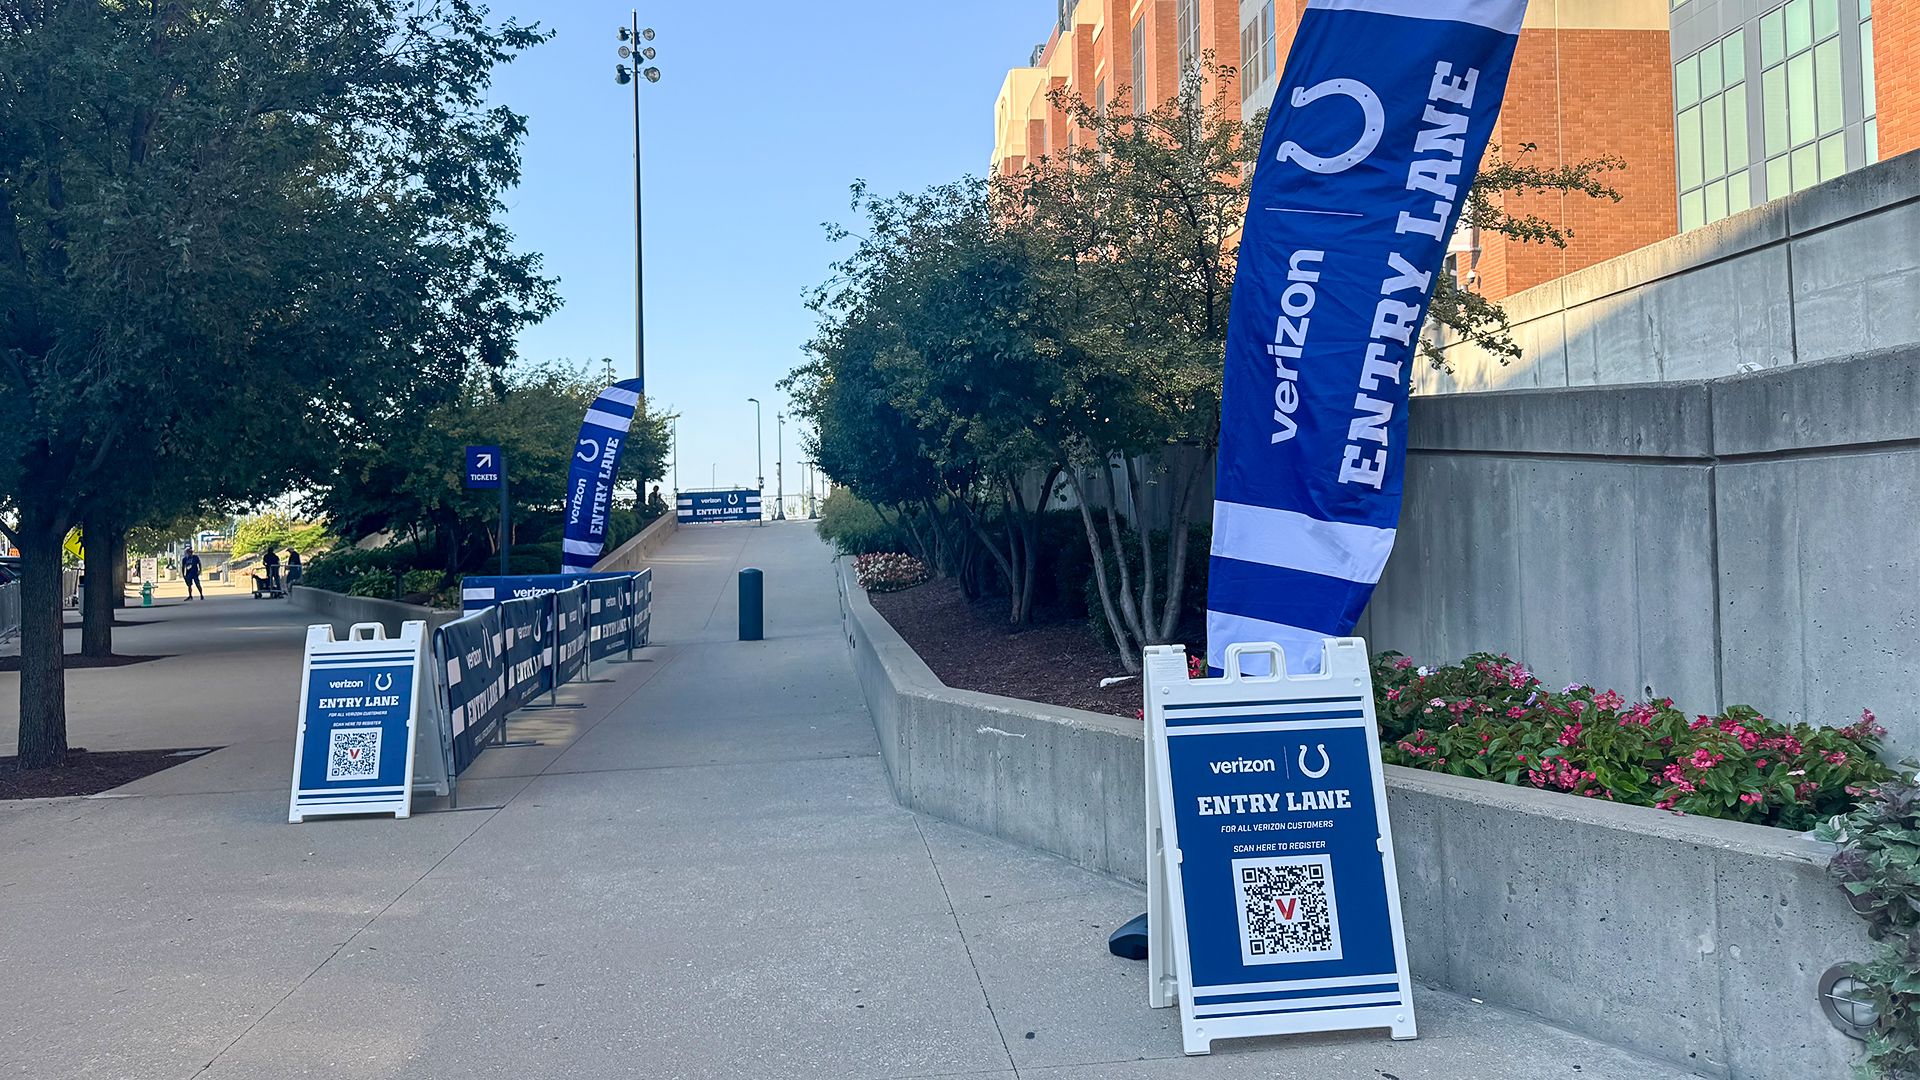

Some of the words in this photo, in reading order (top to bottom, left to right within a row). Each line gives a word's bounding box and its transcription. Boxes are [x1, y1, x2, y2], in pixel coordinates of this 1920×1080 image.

[1338, 252, 1432, 489] ENTRY
[1395, 60, 1480, 242] LANE
[1267, 249, 1325, 445] verizon
[598, 436, 620, 480] LANE
[470, 473, 498, 481] TICKETS
[570, 478, 587, 525] verizon
[590, 479, 609, 536] ENTRY
[696, 507, 722, 516] ENTRY
[723, 506, 743, 515] LANE
[513, 586, 555, 599] verizon
[329, 679, 364, 689] verizon
[319, 697, 363, 709] ENTRY
[365, 695, 400, 708] LANE
[467, 689, 488, 727] ENTRY
[1209, 757, 1276, 774] verizon
[1197, 793, 1280, 816] ENTRY
[1285, 789, 1352, 812] LANE
[1221, 825, 1236, 833] FOR
[1237, 824, 1252, 832] ALL
[1253, 822, 1286, 832] VERIZON
[1287, 820, 1334, 830] CUSTOMERS
[1233, 845, 1255, 853] SCAN
[1256, 843, 1276, 852] HERE
[1278, 843, 1288, 851] TO
[1289, 841, 1326, 850] REGISTER
